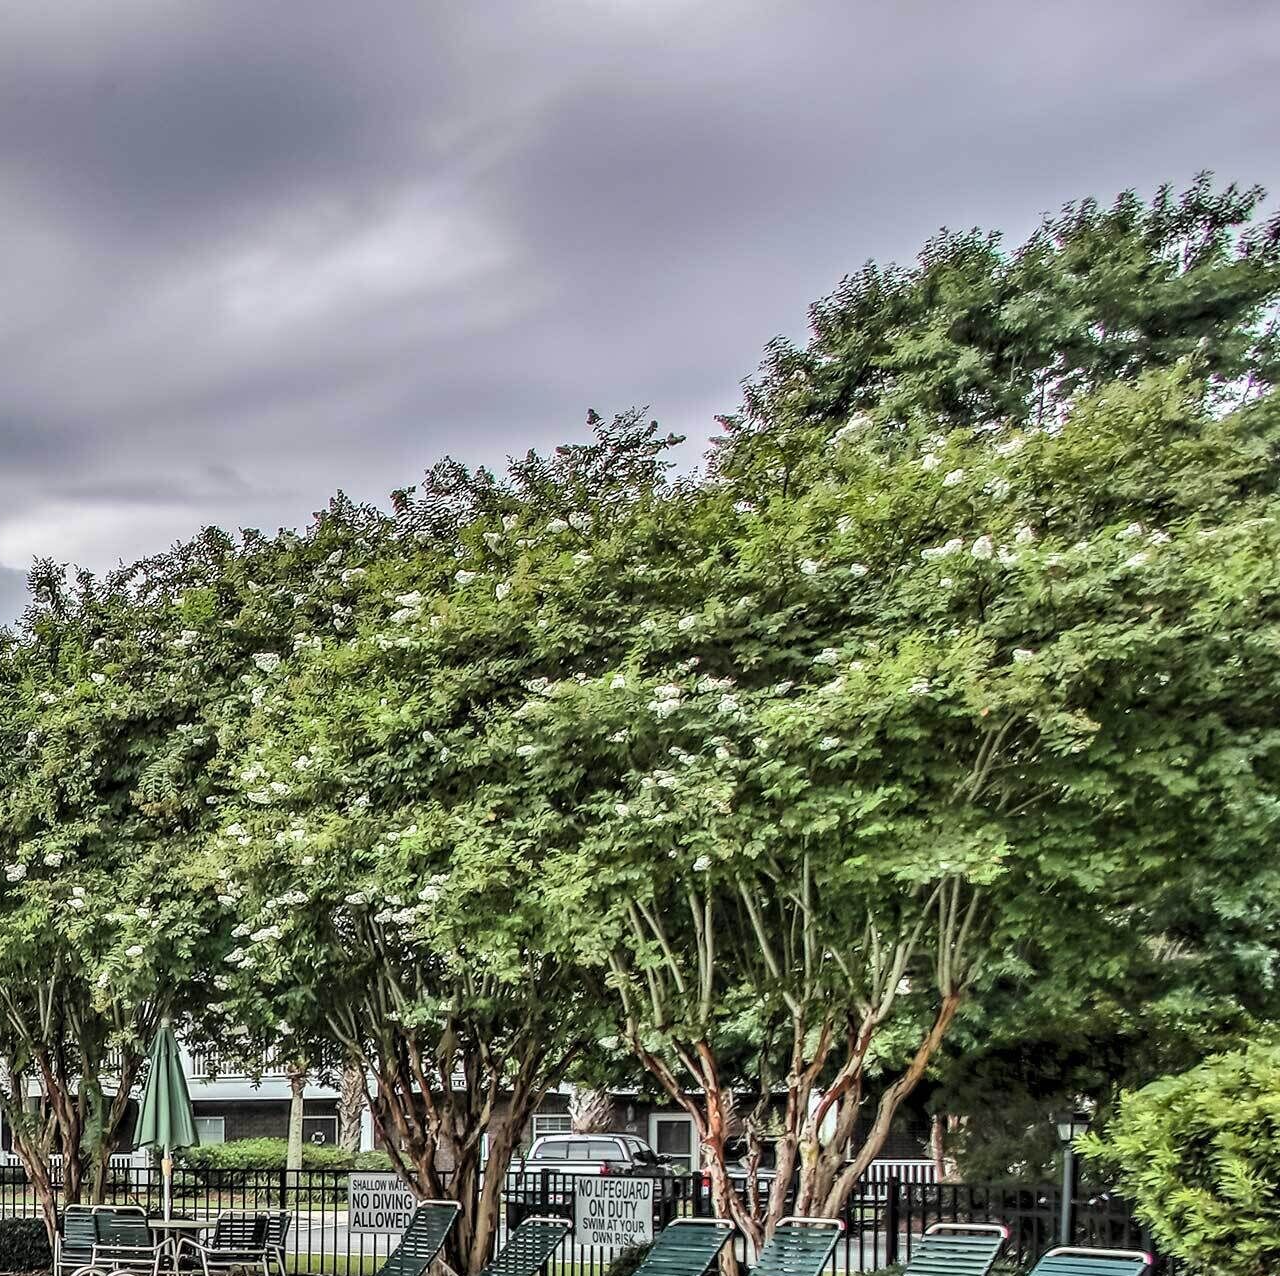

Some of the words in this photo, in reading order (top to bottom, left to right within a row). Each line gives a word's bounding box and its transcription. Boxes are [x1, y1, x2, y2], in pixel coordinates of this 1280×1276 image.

[352, 1180, 387, 1191] SHALLOW
[388, 1179, 409, 1191] WATE
[579, 1179, 592, 1197] NO
[595, 1180, 650, 1200] LIFEGUARD
[352, 1193, 369, 1209] NO
[373, 1193, 413, 1210] DIVING
[589, 1199, 605, 1217] ON
[608, 1200, 638, 1219] DUTY
[353, 1211, 412, 1229] ALLOWED
[583, 1217, 605, 1231] SWIM
[607, 1219, 618, 1231] AT
[620, 1220, 645, 1234] YOUR
[592, 1231, 613, 1244] OWN
[615, 1232, 635, 1246] RISK
